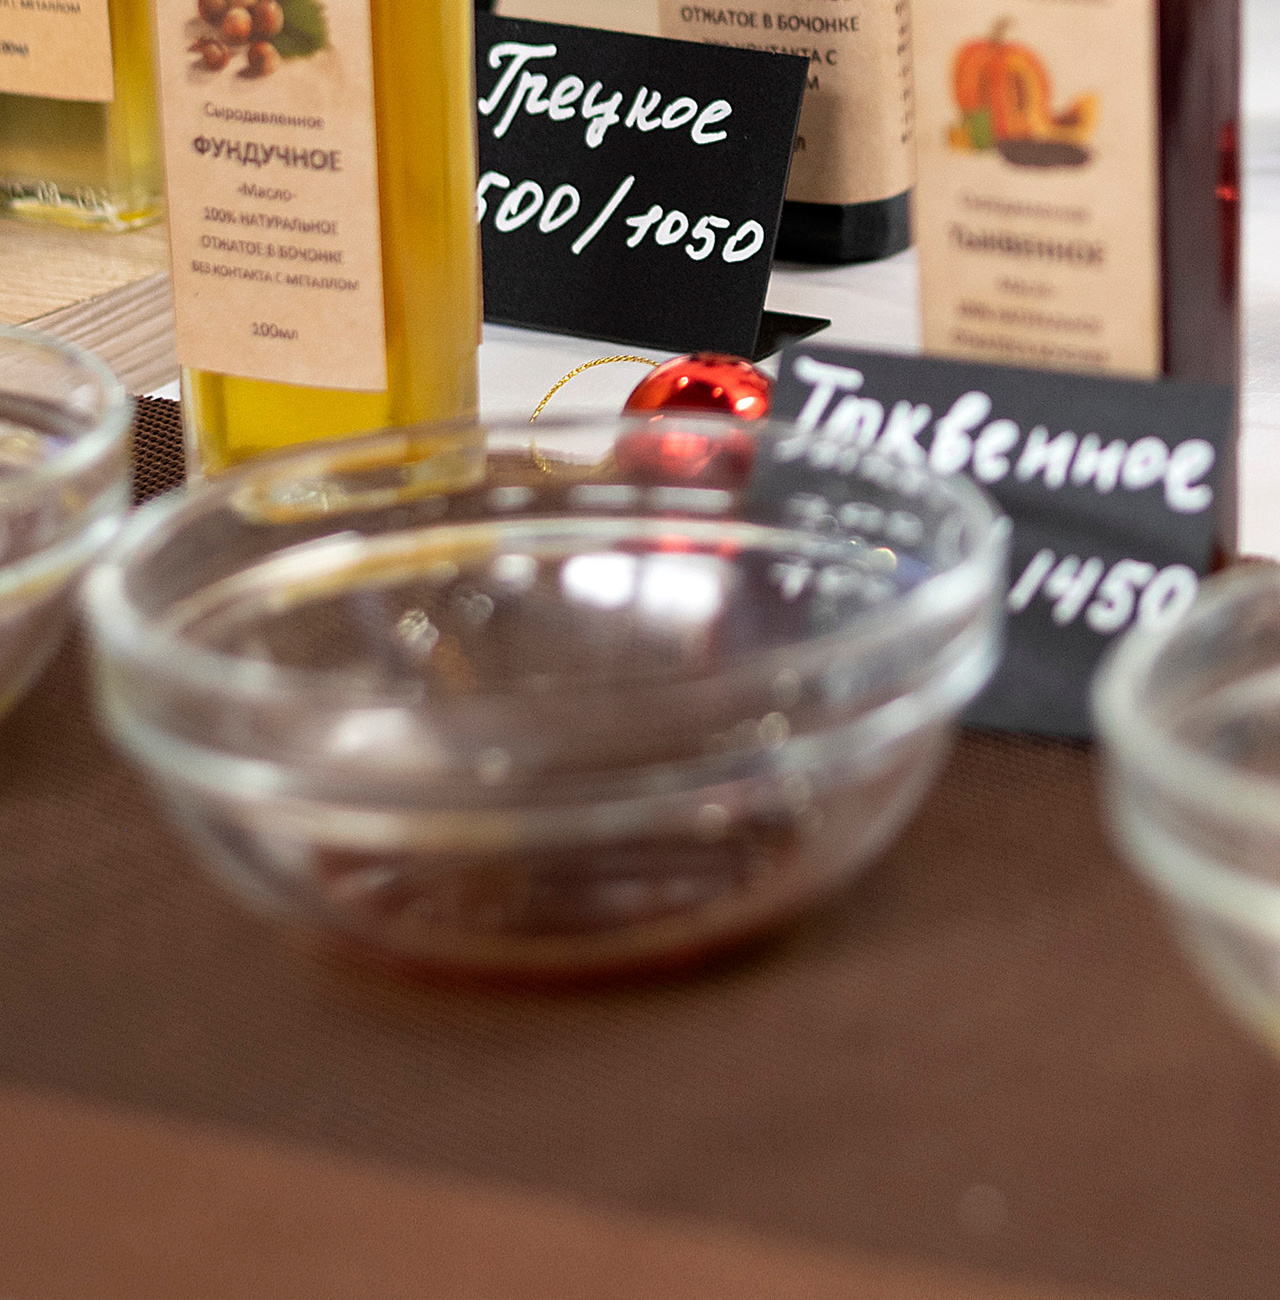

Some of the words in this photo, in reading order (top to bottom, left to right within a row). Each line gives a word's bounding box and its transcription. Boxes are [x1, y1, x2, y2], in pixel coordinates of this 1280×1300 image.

[680, 5, 759, 29] ОТЖАТОЕ
[763, 12, 773, 30] В
[777, 13, 860, 33] БОЧОНКЕ
[477, 41, 733, 148] Грецкое
[204, 101, 325, 130] Сыродавленное
[192, 135, 342, 172] ФУНДУЧНОЕ
